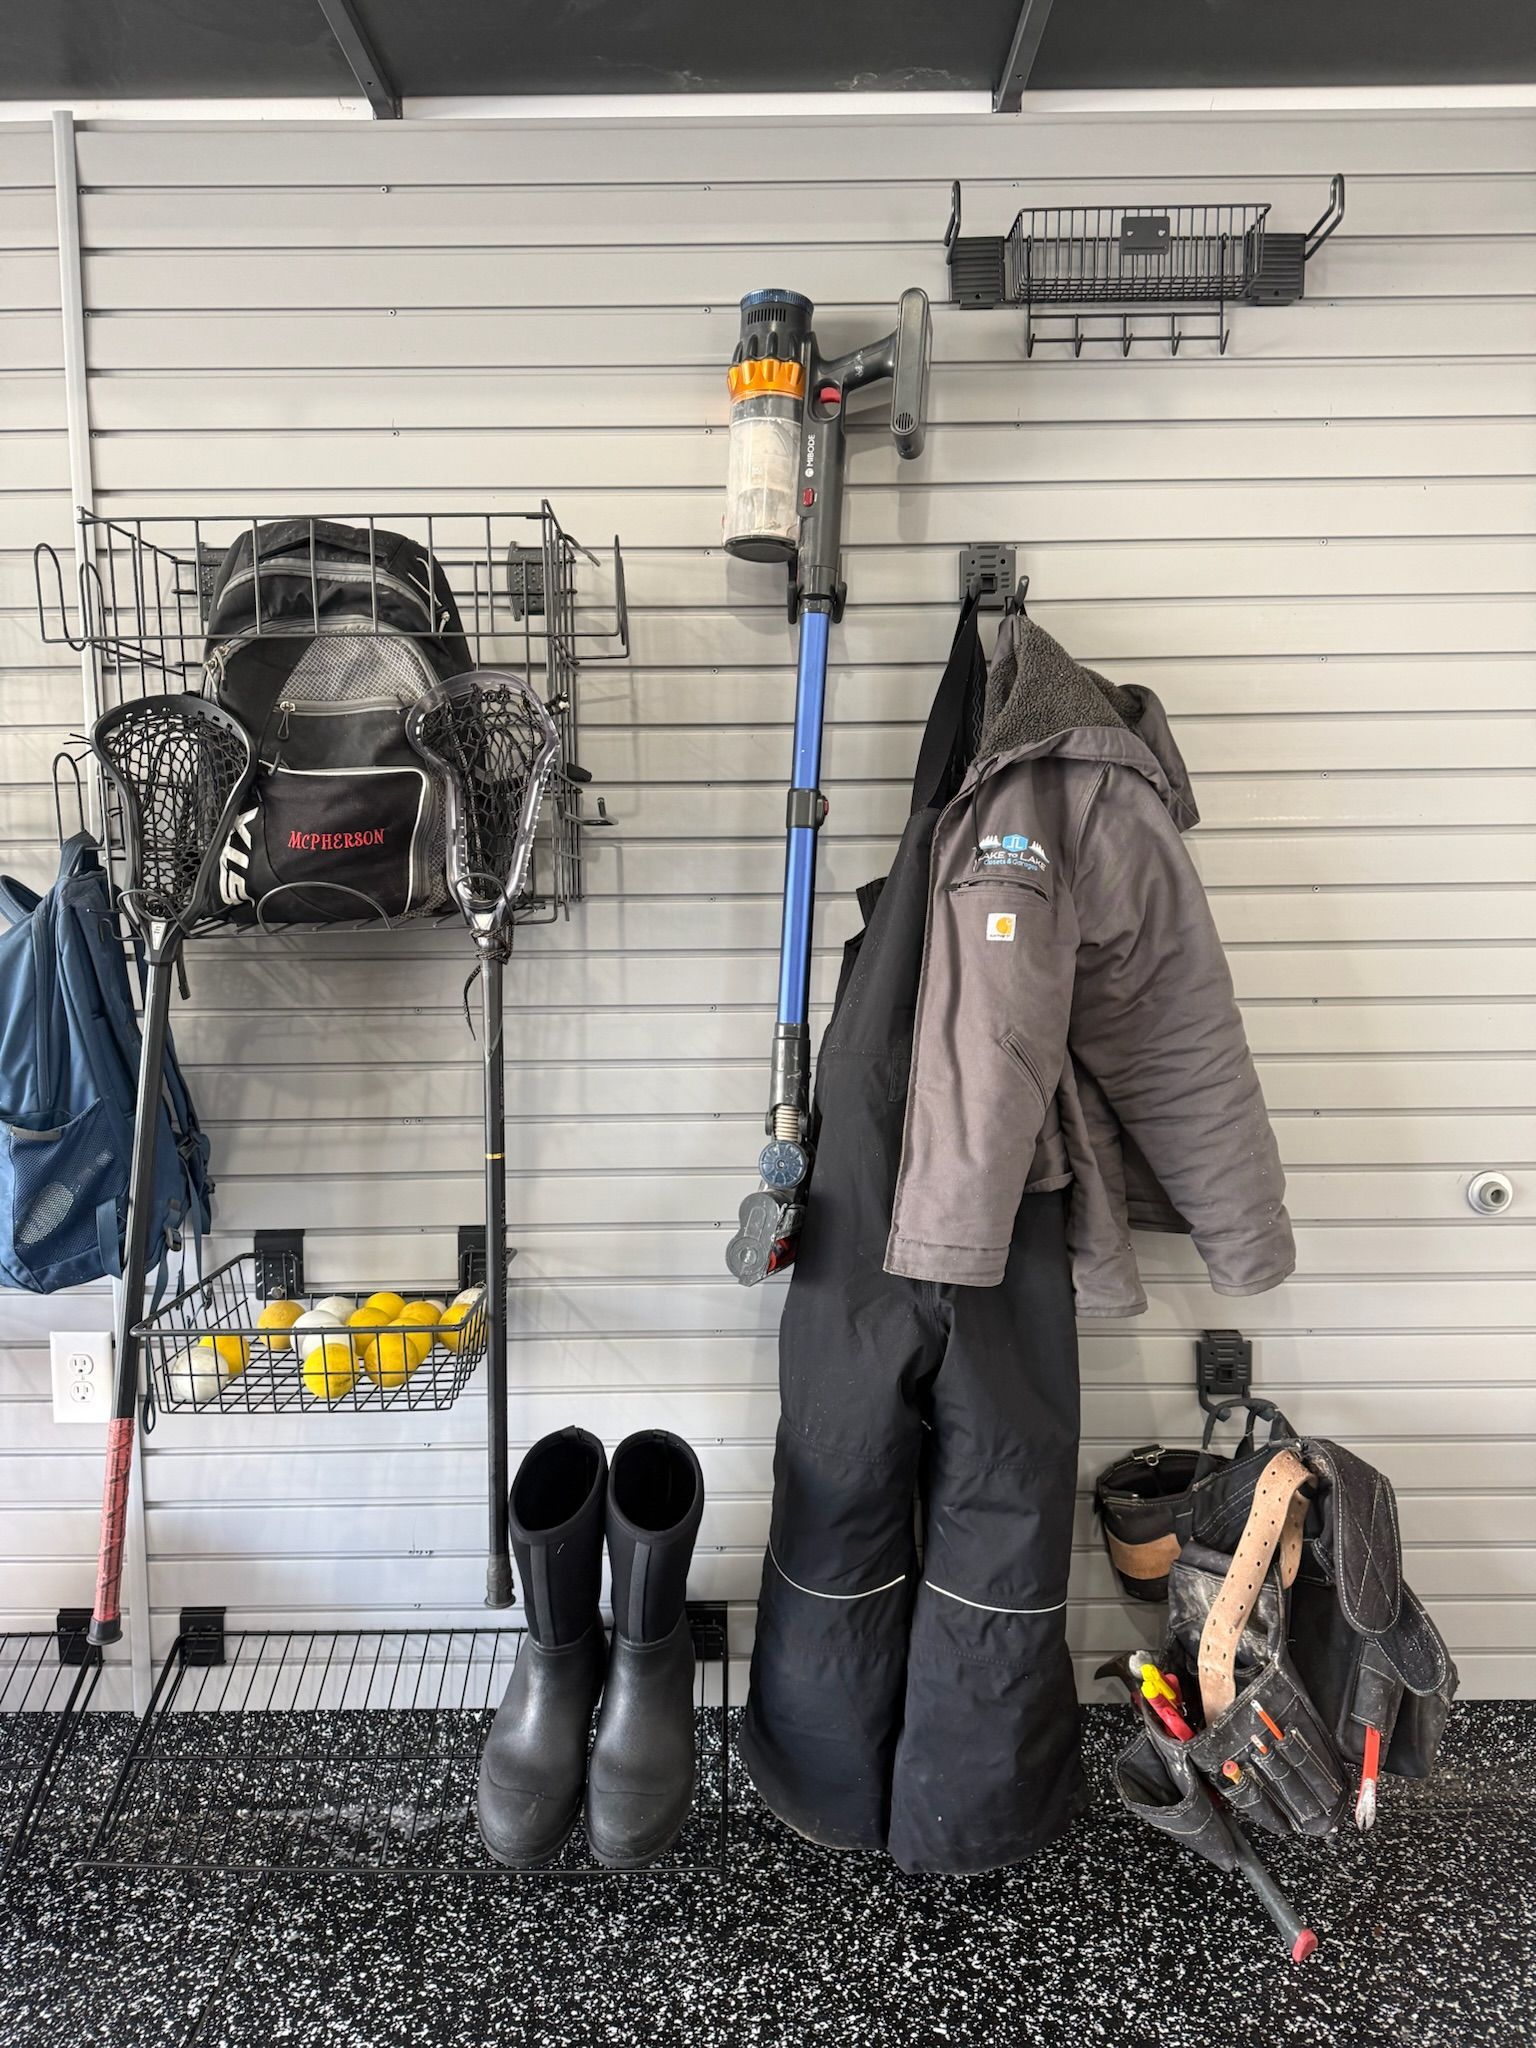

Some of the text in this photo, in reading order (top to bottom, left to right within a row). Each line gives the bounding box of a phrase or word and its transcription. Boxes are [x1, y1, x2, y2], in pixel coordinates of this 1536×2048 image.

[806, 434, 816, 467] MIBODE
[219, 806, 259, 908] STX
[978, 850, 1006, 862] AKE
[1020, 851, 1047, 872] LAKE
